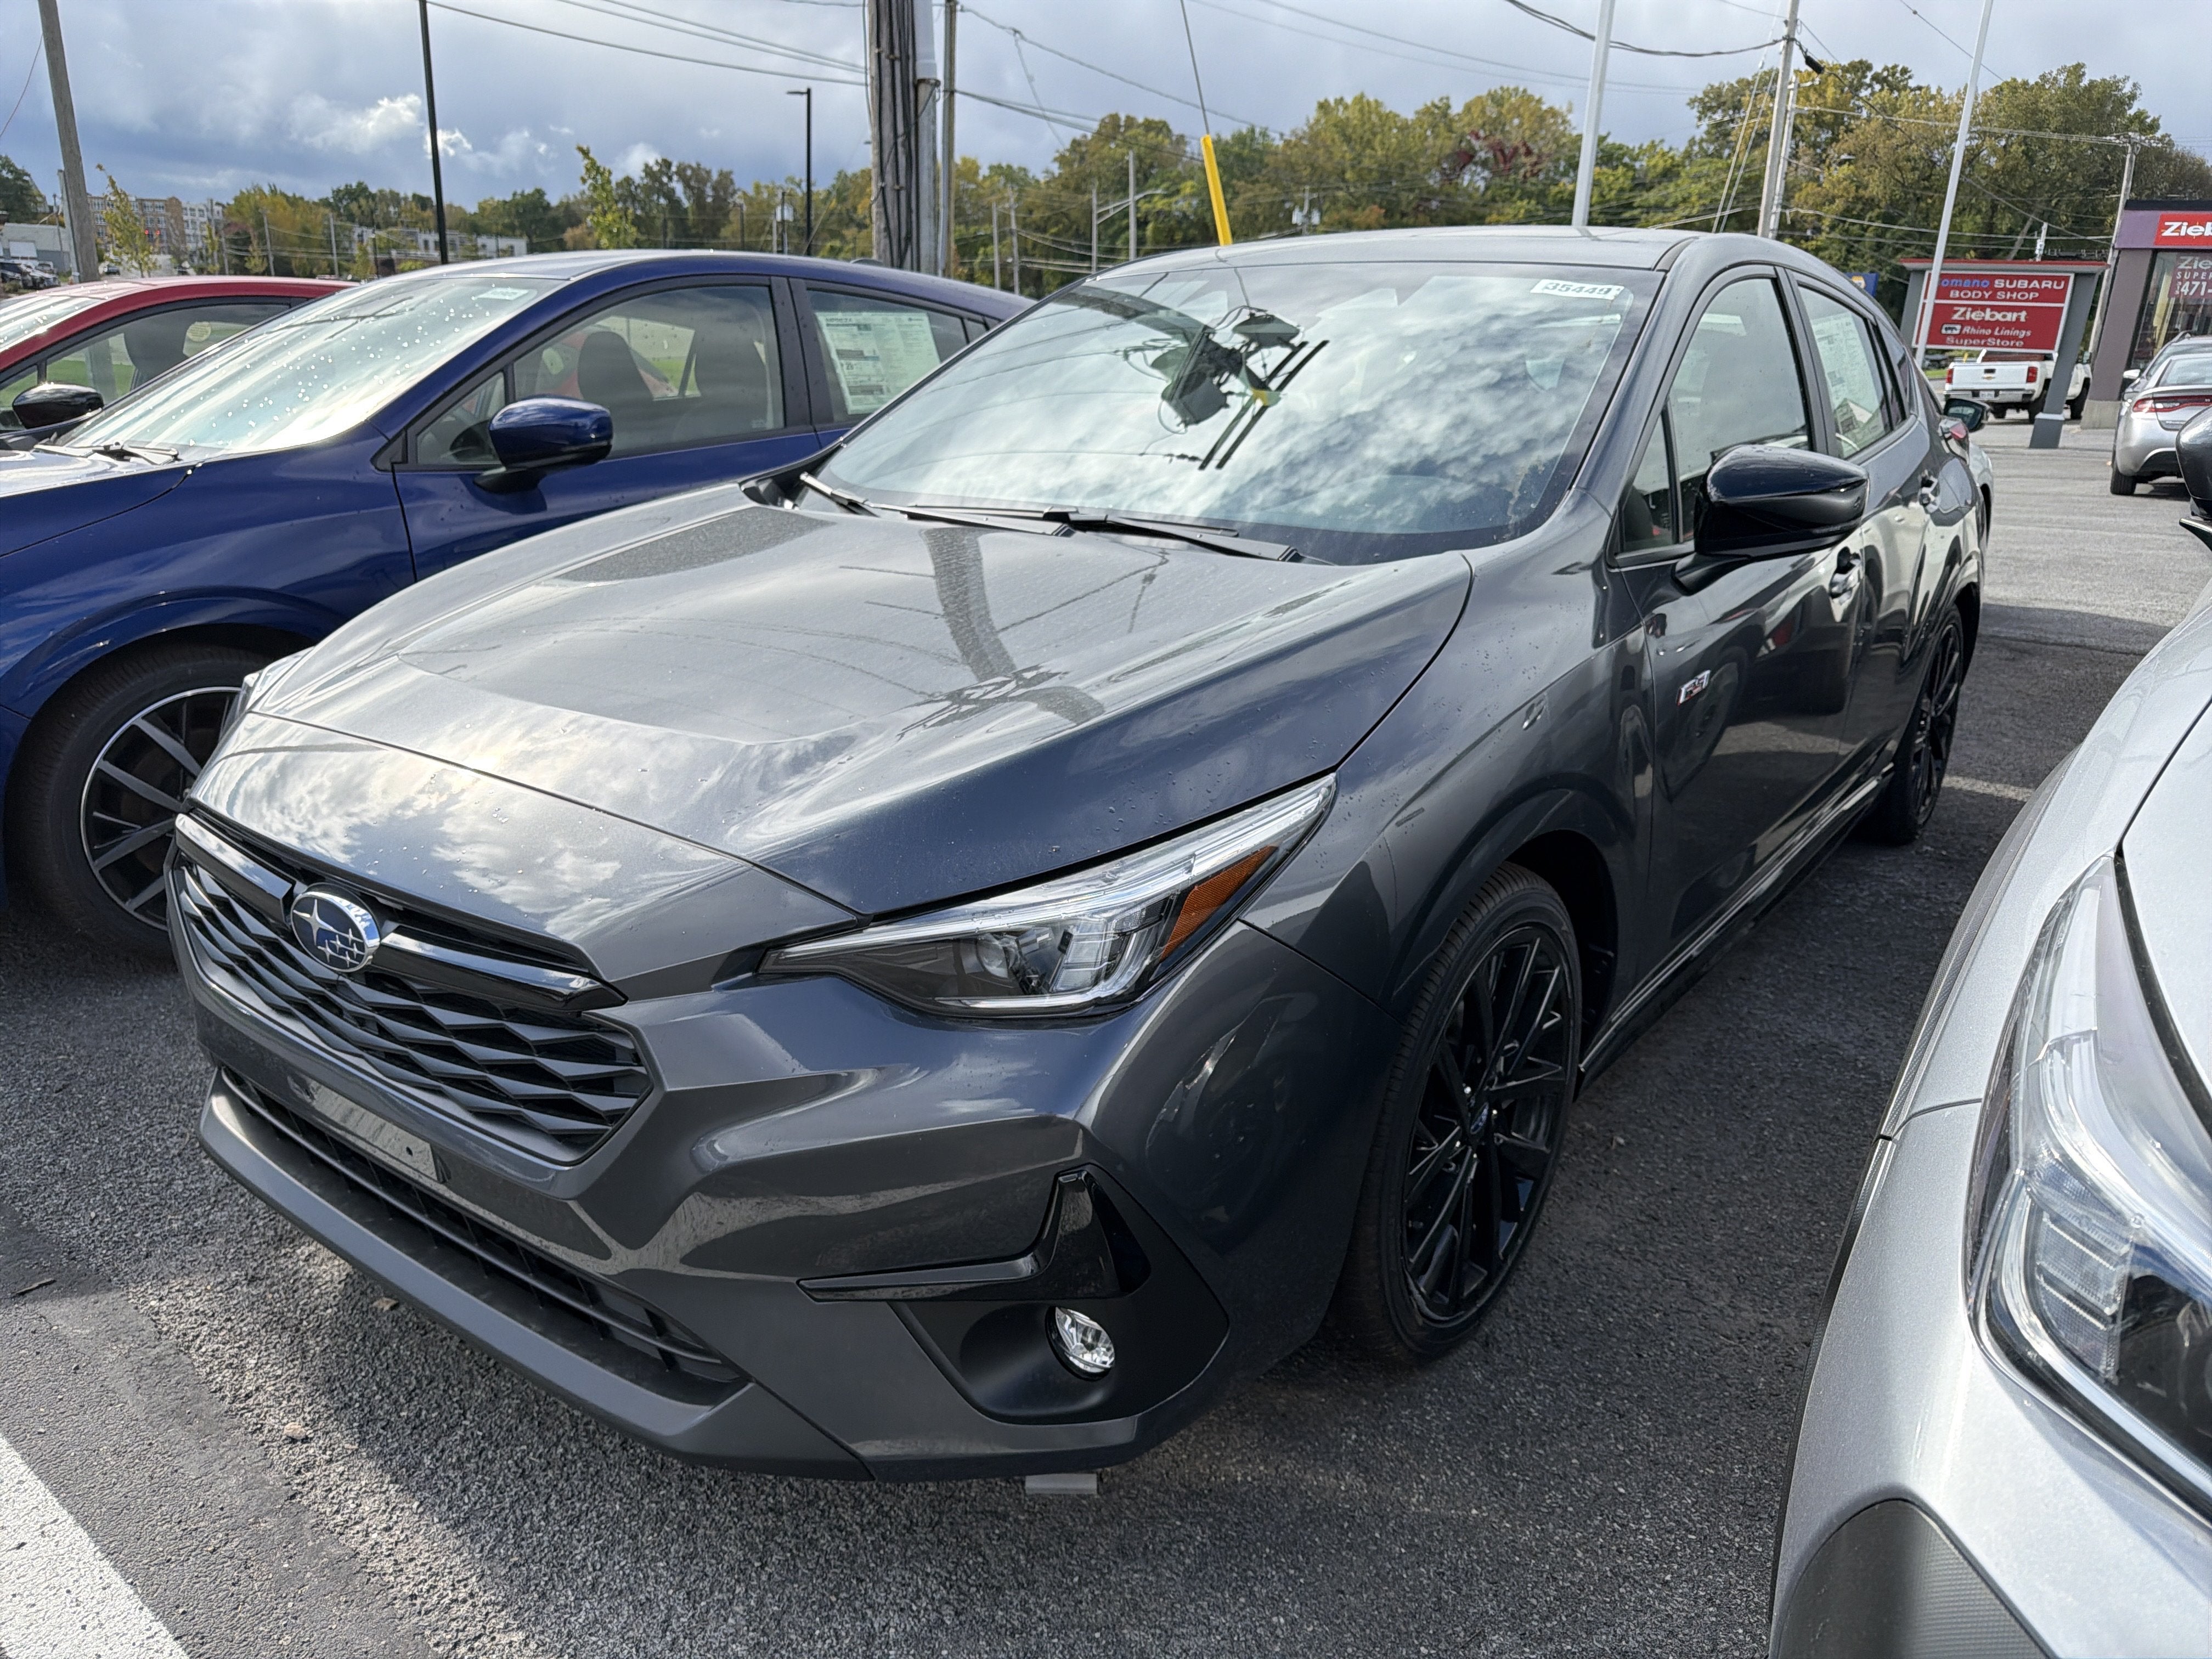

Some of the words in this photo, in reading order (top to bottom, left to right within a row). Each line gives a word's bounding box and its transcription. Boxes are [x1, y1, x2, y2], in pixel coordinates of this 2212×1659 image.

[1543, 283, 1612, 295] 35449
[1939, 278, 1990, 287] omano
[1994, 279, 2066, 290] SUBARU
[1949, 290, 1993, 298] BODY
[1996, 291, 2040, 300] SHOP
[1951, 306, 2028, 323] Ziebart
[1962, 325, 1992, 335] Rhino
[1993, 326, 2032, 338] Linings
[1946, 336, 2024, 347] SuperStore
